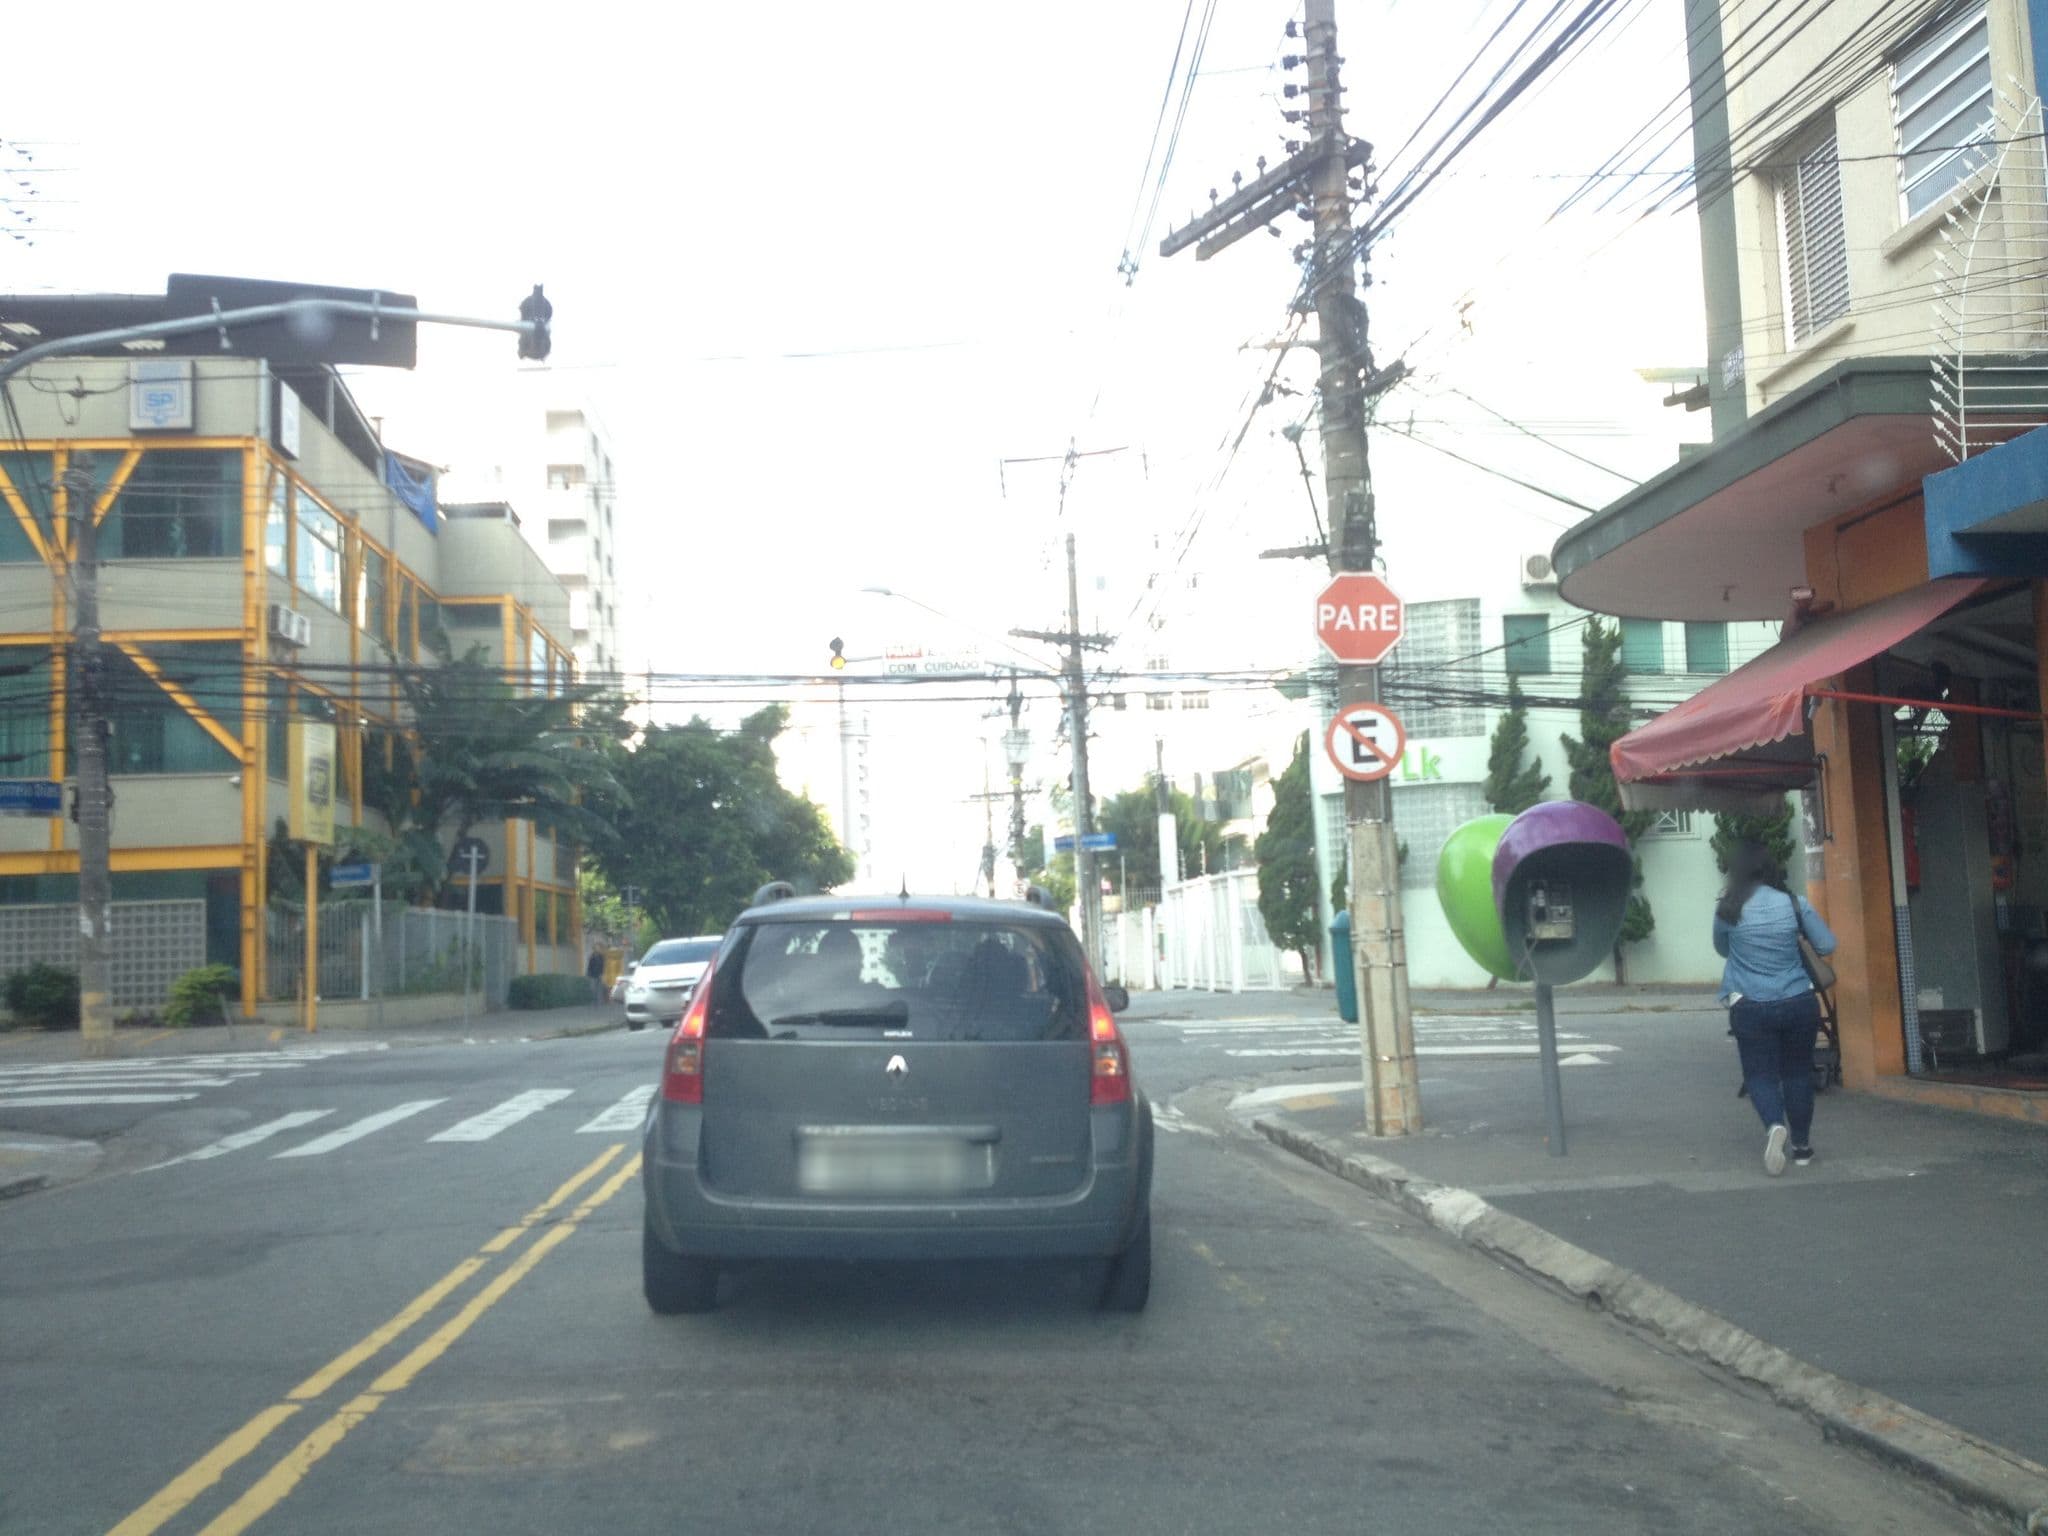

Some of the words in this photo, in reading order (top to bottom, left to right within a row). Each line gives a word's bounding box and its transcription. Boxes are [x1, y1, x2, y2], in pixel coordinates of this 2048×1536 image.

[1318, 604, 1399, 632] PARE
[888, 663, 918, 674] COM
[924, 660, 980, 673] CUIDADO
[1351, 719, 1381, 764] E
